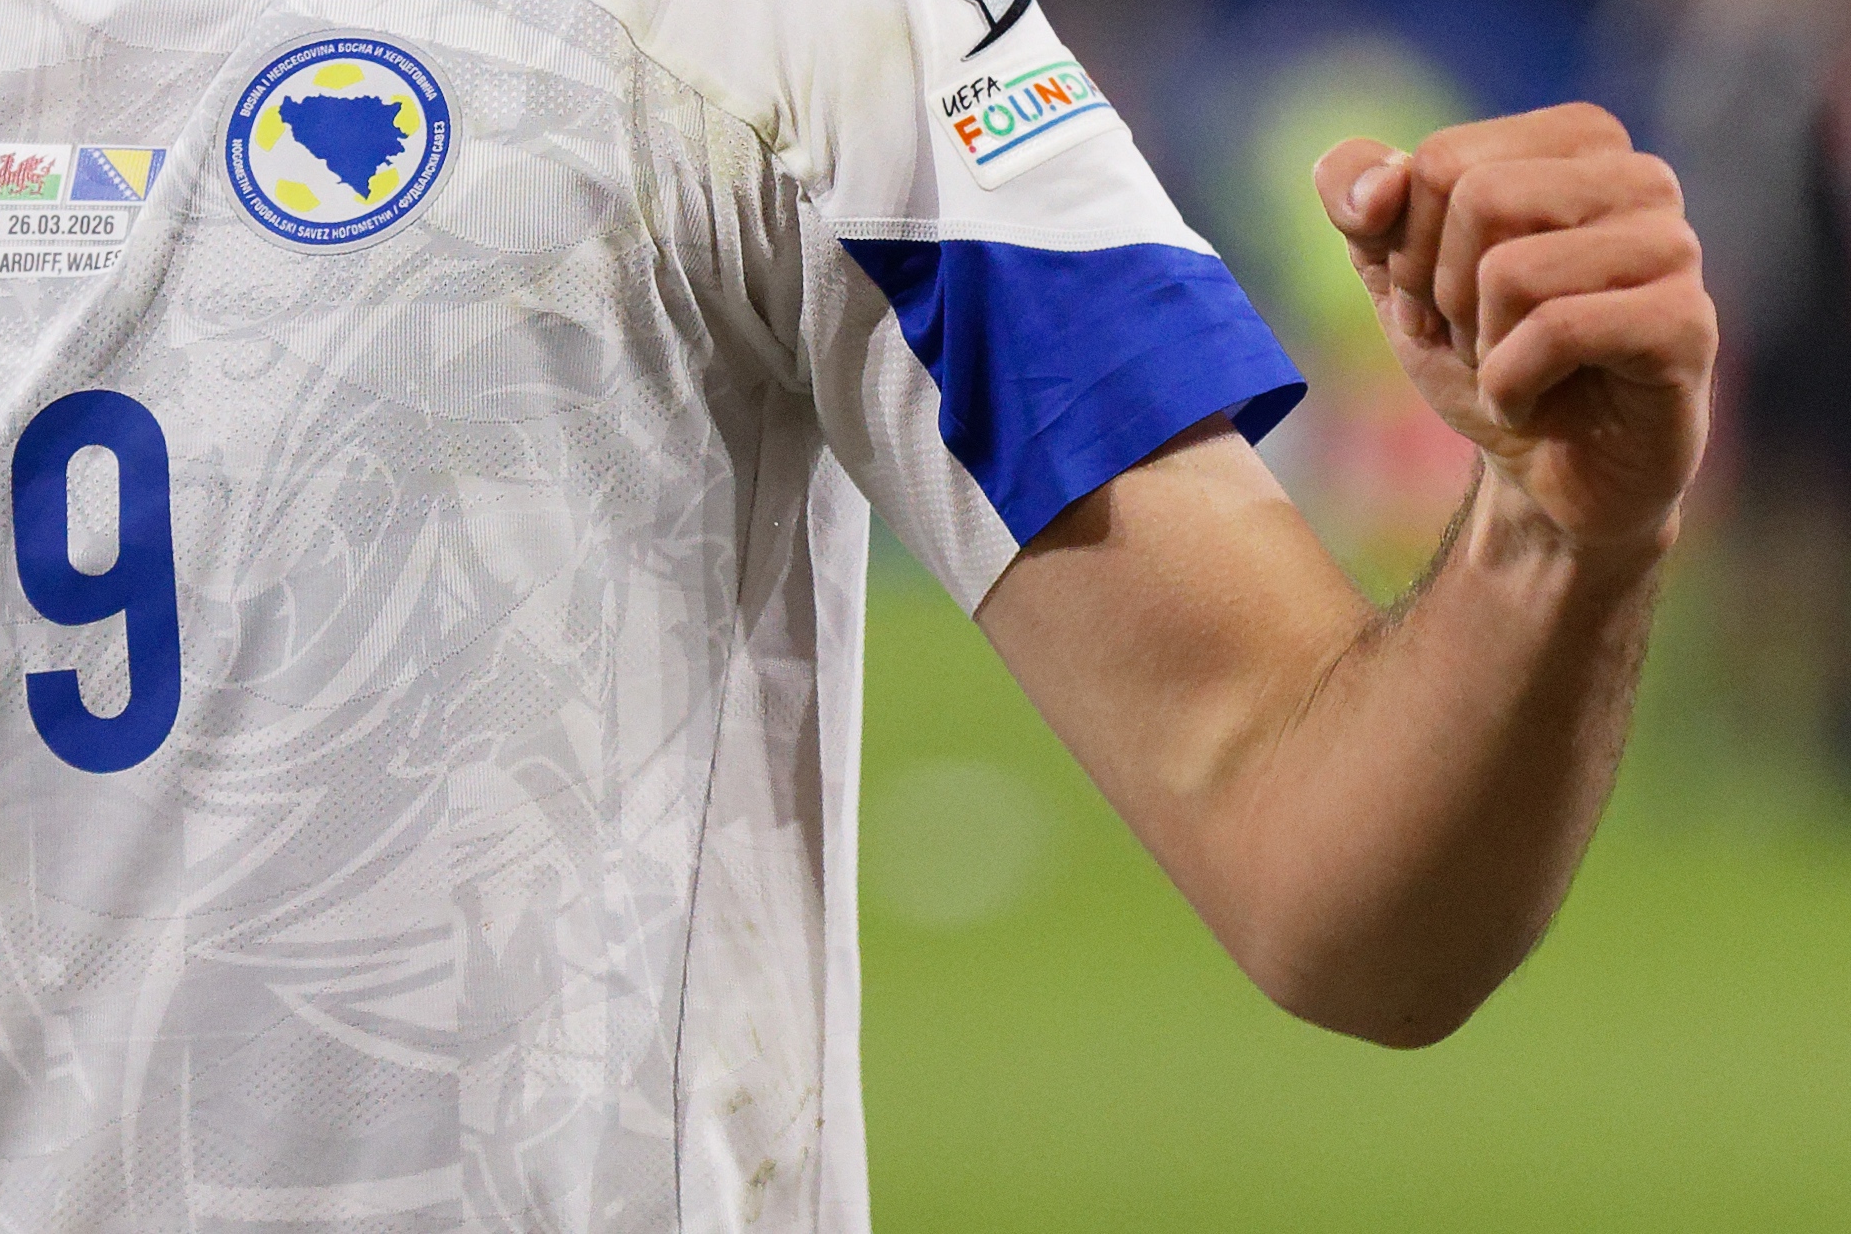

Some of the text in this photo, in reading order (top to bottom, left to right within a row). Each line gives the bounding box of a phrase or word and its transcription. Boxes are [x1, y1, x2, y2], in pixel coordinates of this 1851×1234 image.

[239, 85, 267, 118] BOSNA
[266, 44, 336, 82] HERCEGOVINA
[942, 76, 1001, 117] UEFA
[232, 138, 253, 195] NOGOMETNI
[250, 197, 297, 234] FUDBALSKI
[297, 226, 330, 240] SAVEZ
[8, 215, 115, 235] 26.03.2026
